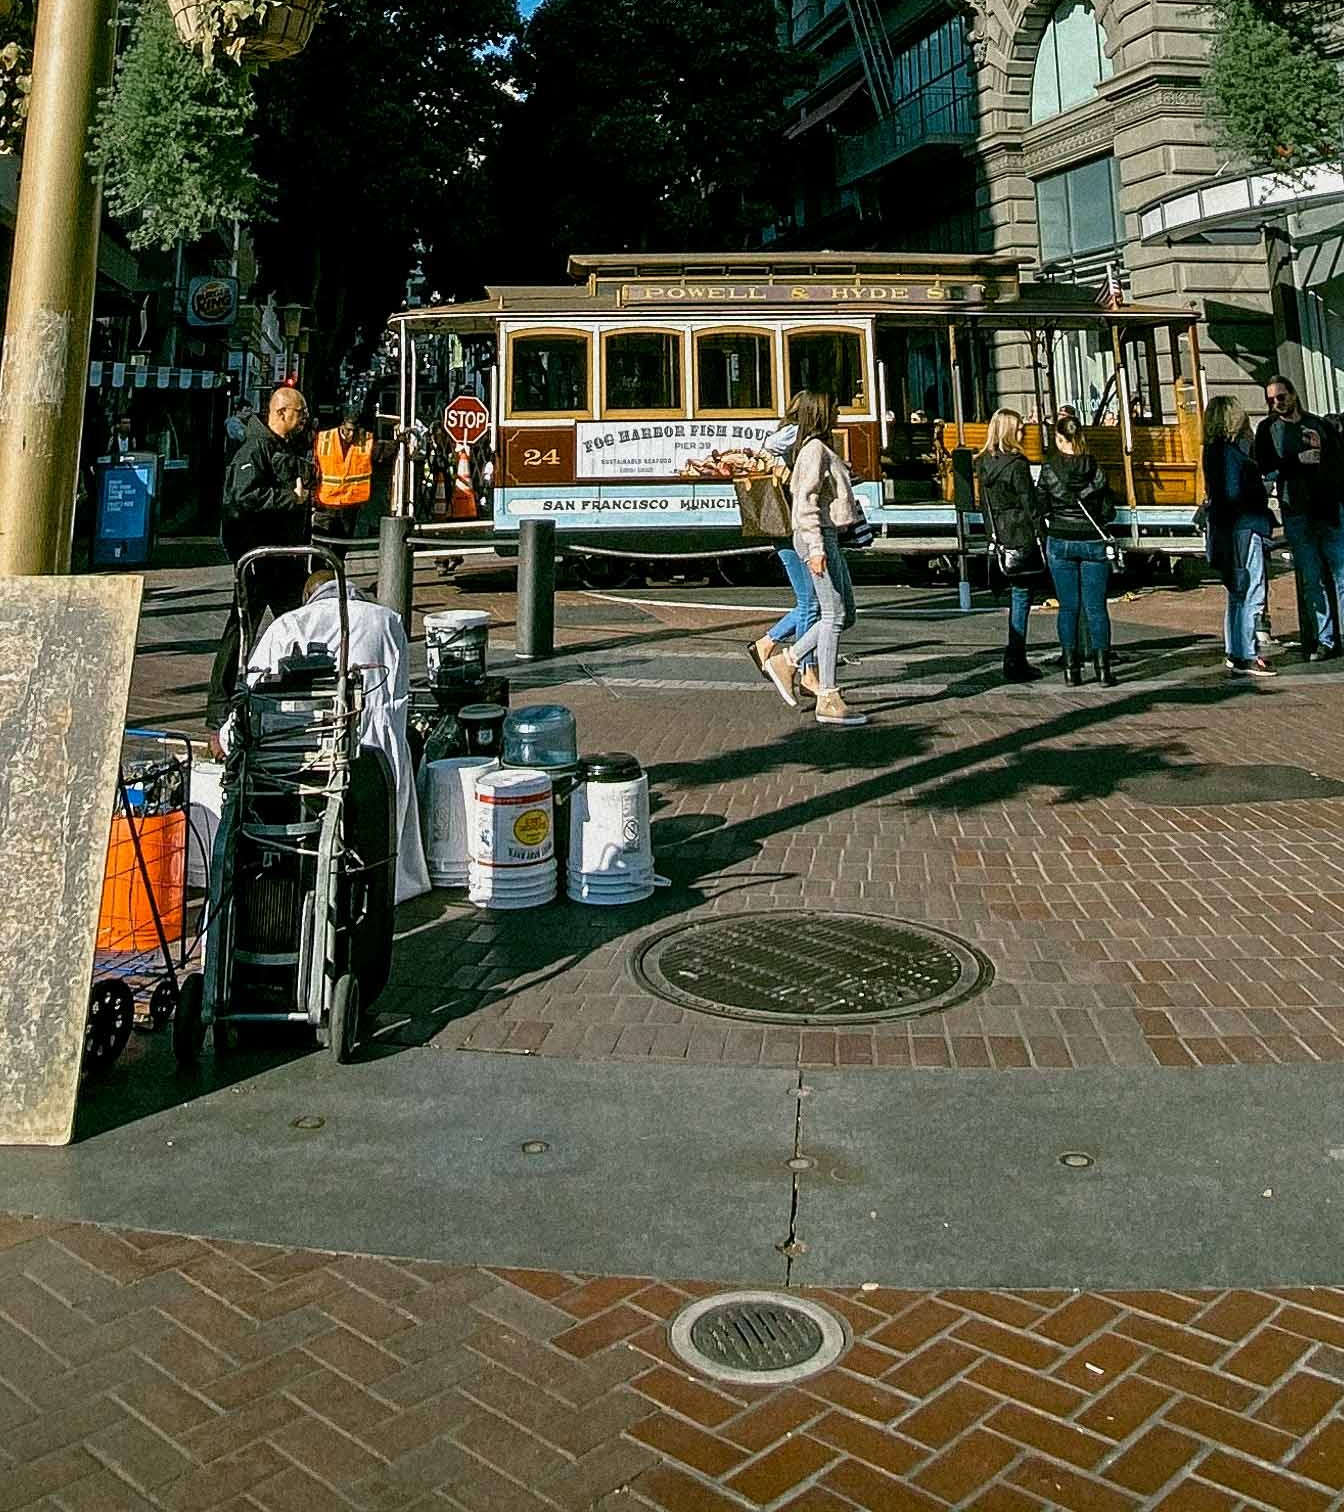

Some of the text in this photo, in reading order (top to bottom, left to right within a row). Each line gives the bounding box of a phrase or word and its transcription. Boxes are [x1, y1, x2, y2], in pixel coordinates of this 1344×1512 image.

[642, 287, 768, 300] POWELL
[790, 285, 810, 300] &
[830, 287, 911, 300] HYDE
[448, 408, 486, 429] STOP
[582, 433, 615, 453] FOG
[618, 424, 686, 444] HARBOR
[689, 424, 728, 438] FISH
[674, 441, 712, 450] PIER 39
[522, 448, 561, 466] 24
[543, 500, 576, 511] SAN
[581, 499, 669, 511] FRANCISCO
